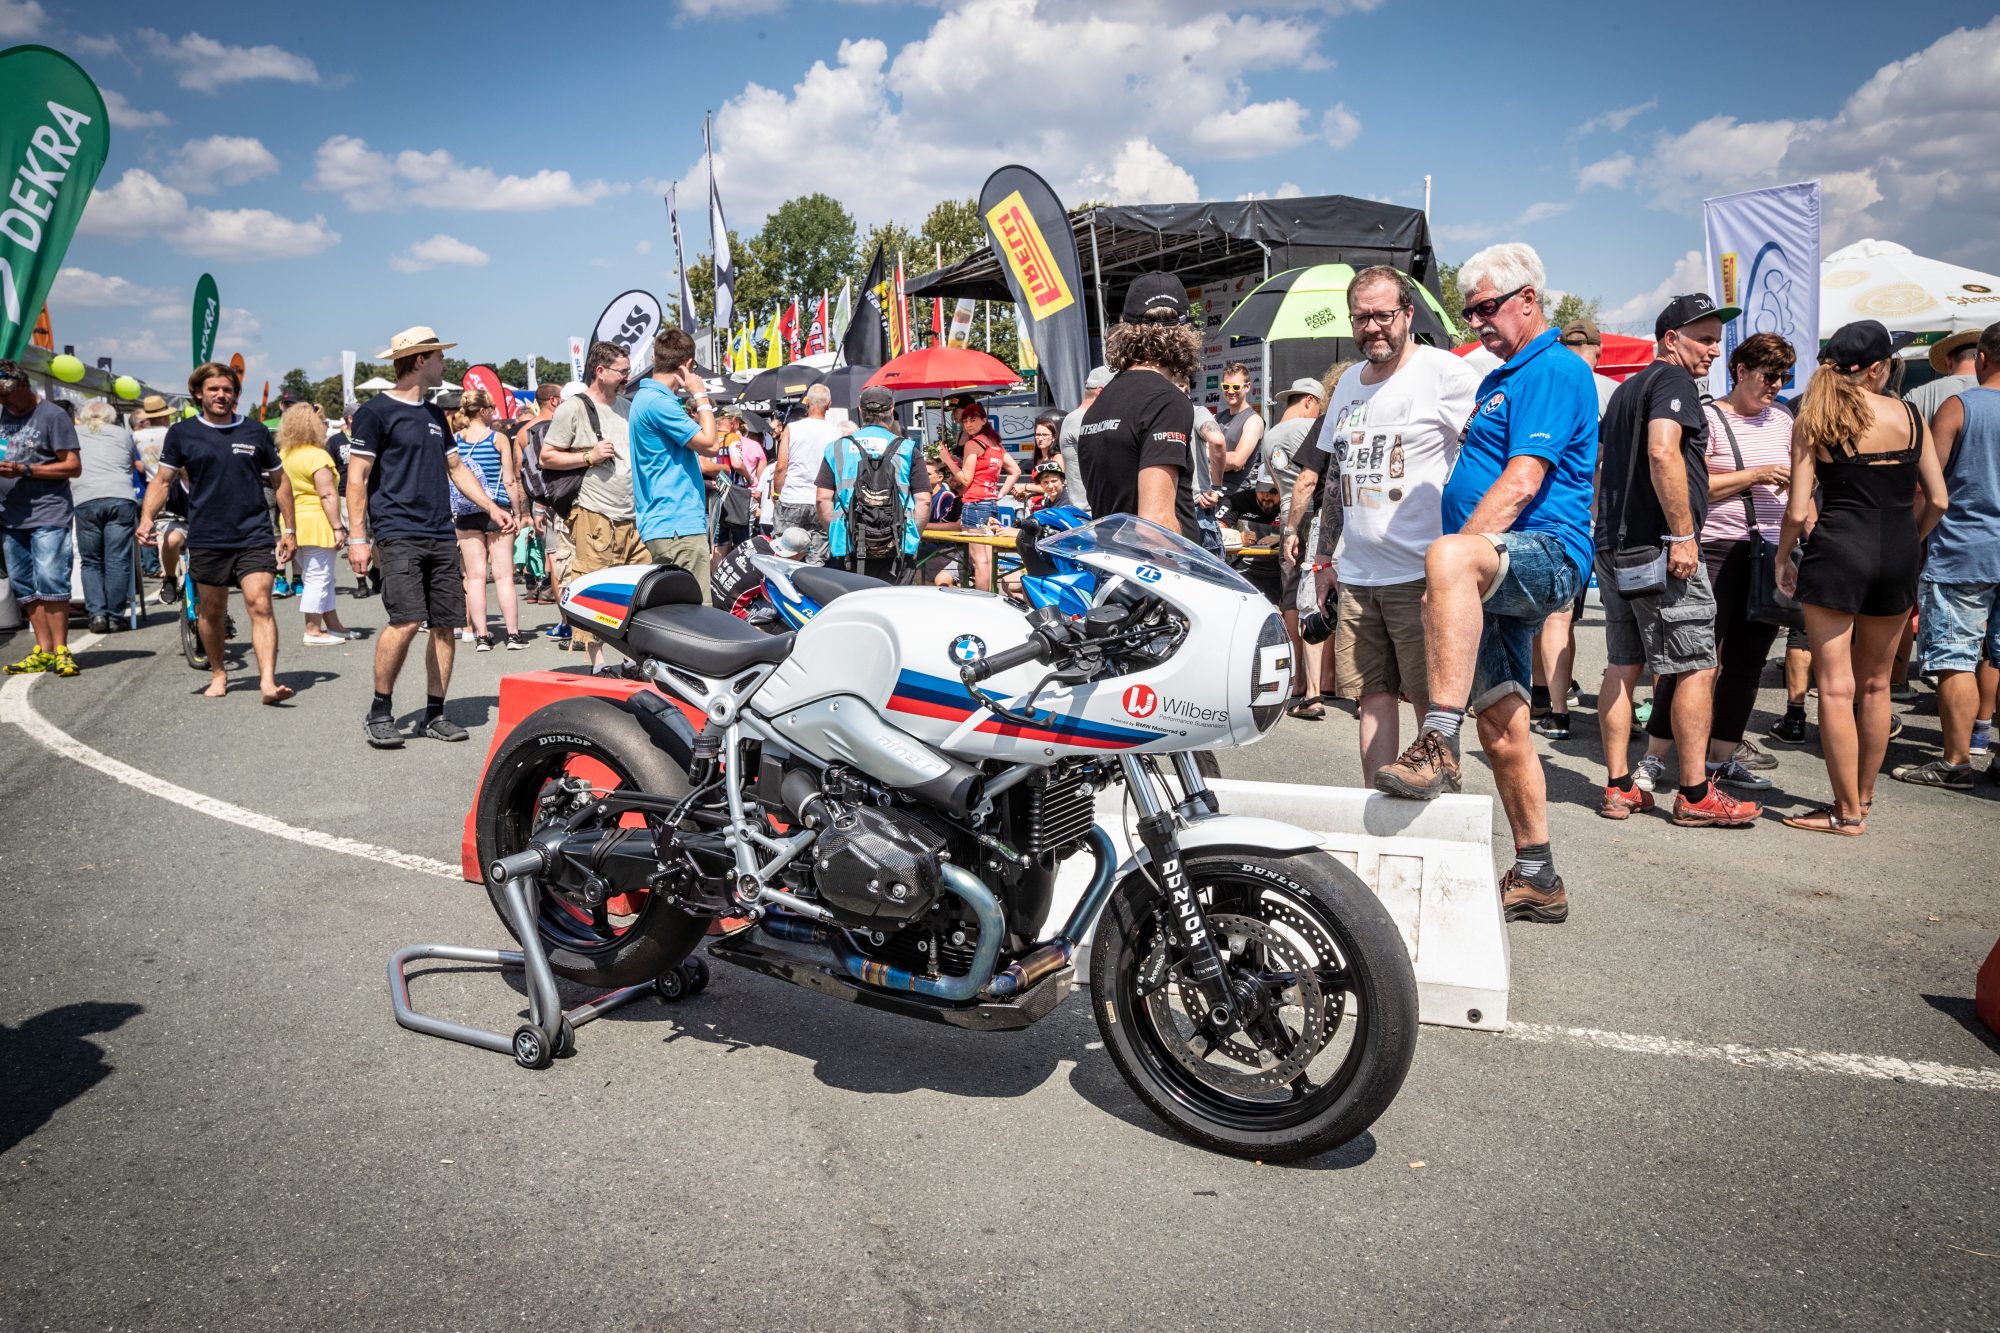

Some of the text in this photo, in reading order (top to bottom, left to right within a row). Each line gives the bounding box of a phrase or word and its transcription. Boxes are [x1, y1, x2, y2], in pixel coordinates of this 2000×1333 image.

[0, 101, 92, 253] DEKRA
[1205, 393, 1220, 403] KTM
[1138, 567, 1160, 580] ZF
[956, 635, 985, 649] BMW
[1251, 641, 1296, 707] 5
[1163, 696, 1229, 722] Wilbers
[1135, 722, 1151, 730] BMW
[1152, 725, 1179, 735] Motorrad
[1158, 714, 1226, 729] Performance Suspension
[538, 734, 592, 747] DUNLOP
[541, 795, 557, 805] BMW
[1241, 864, 1312, 896] DUNLOP
[1162, 859, 1206, 946] DUNLOP
[1148, 954, 1166, 983] brembo
